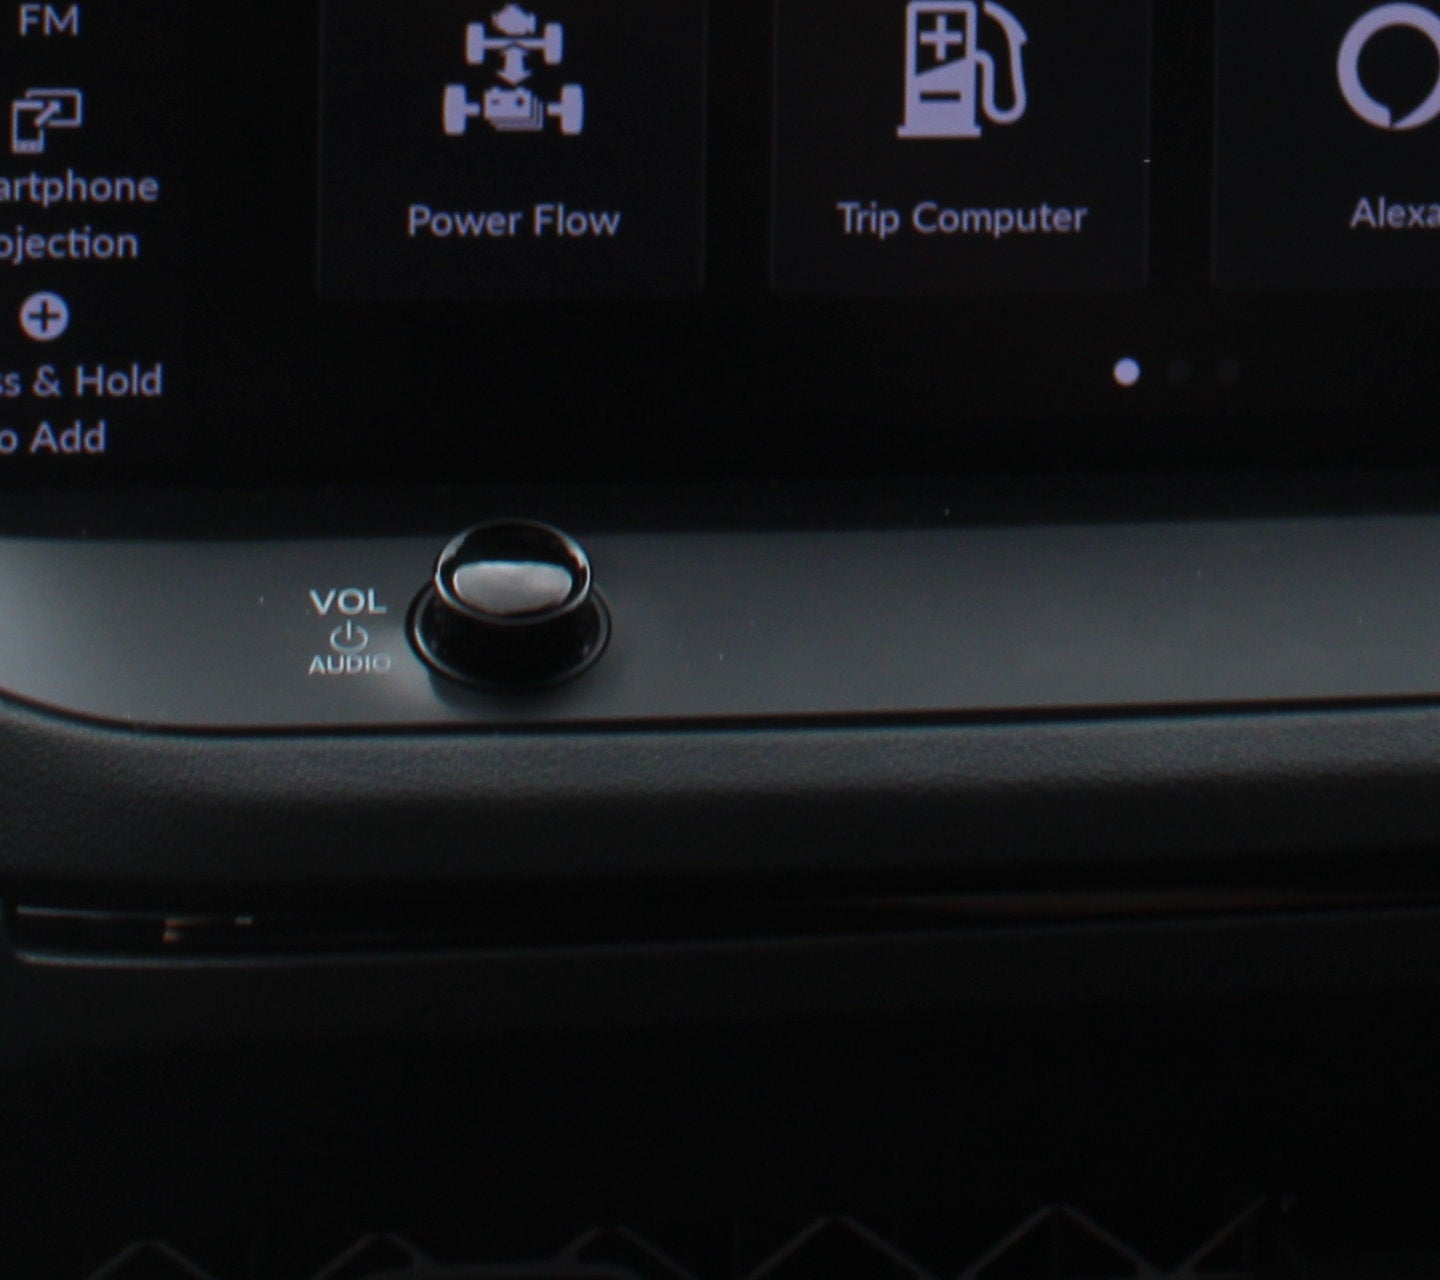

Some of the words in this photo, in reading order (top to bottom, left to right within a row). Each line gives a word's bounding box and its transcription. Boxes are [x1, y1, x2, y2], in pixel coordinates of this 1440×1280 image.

[18, 2, 81, 37] FM
[407, 203, 524, 238] Power
[532, 202, 622, 237] Flow
[836, 200, 902, 241] Trip
[910, 200, 1089, 240] Computer
[31, 363, 62, 399] &
[74, 362, 164, 398] Hold
[28, 418, 107, 455] Add
[309, 587, 387, 616] VOL
[307, 653, 392, 676] AUDIO
